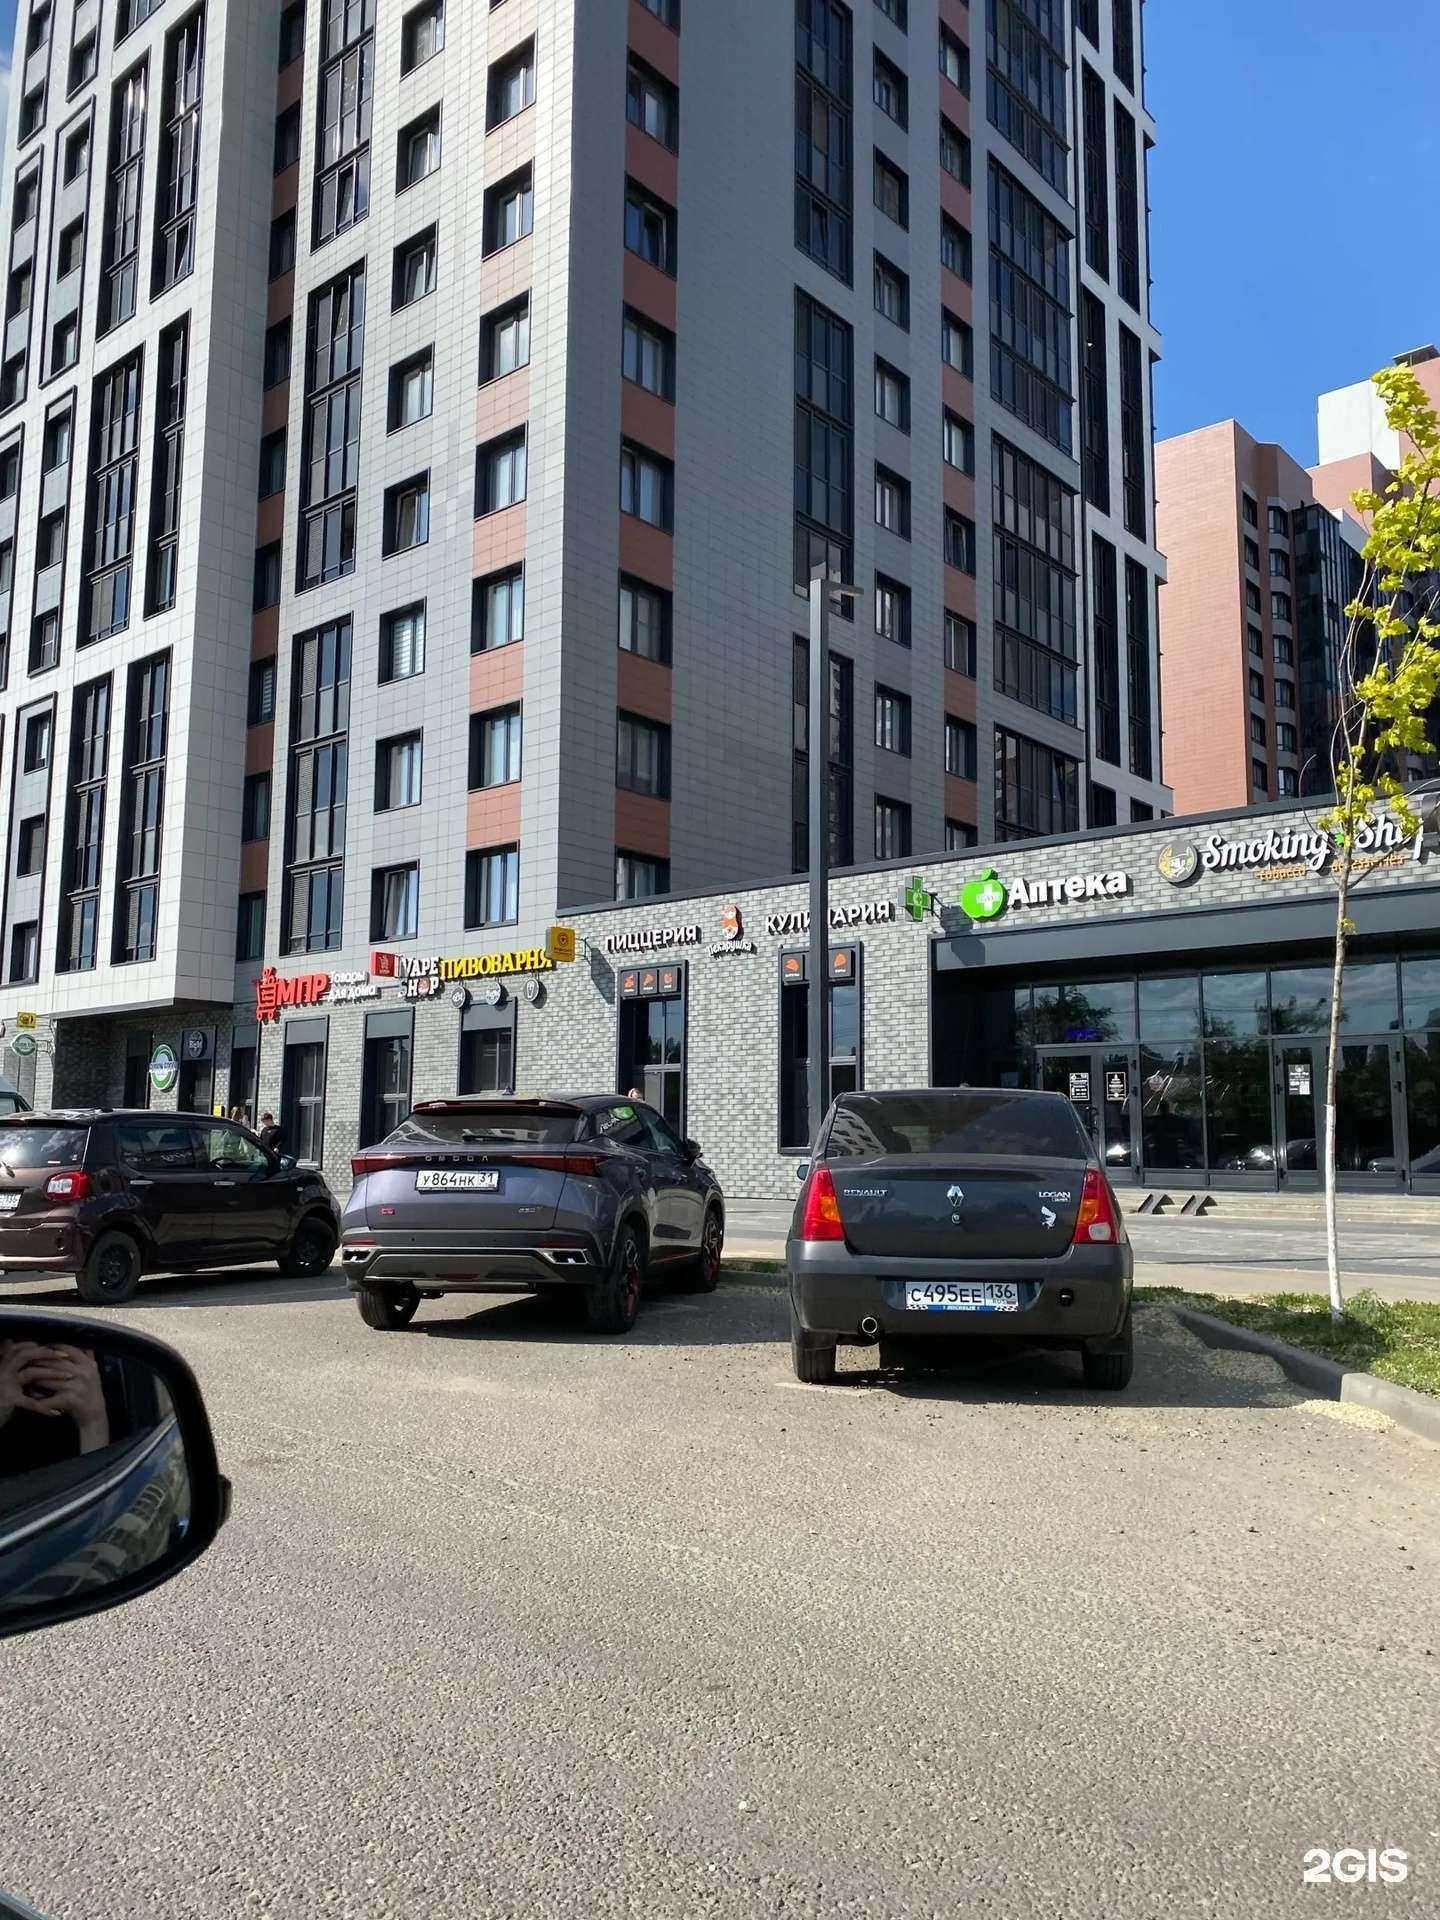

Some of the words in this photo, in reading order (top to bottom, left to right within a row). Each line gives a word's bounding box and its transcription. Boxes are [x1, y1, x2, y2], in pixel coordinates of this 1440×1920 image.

[1202, 827, 1331, 871] Smoking
[1007, 870, 1127, 906] Аптека
[765, 901, 890, 932] КУЛИАРИЯ
[605, 925, 698, 951] ПИЦЦЕРИЯ
[400, 957, 439, 977] VAPE
[439, 948, 552, 980] ПИВОВАРНЯ
[276, 974, 328, 1005] МПР
[480, 1172, 493, 1183] 31
[843, 1189, 888, 1197] RENAULT
[911, 1283, 982, 1303] С495ЕЕ
[986, 1283, 1013, 1299] 136
